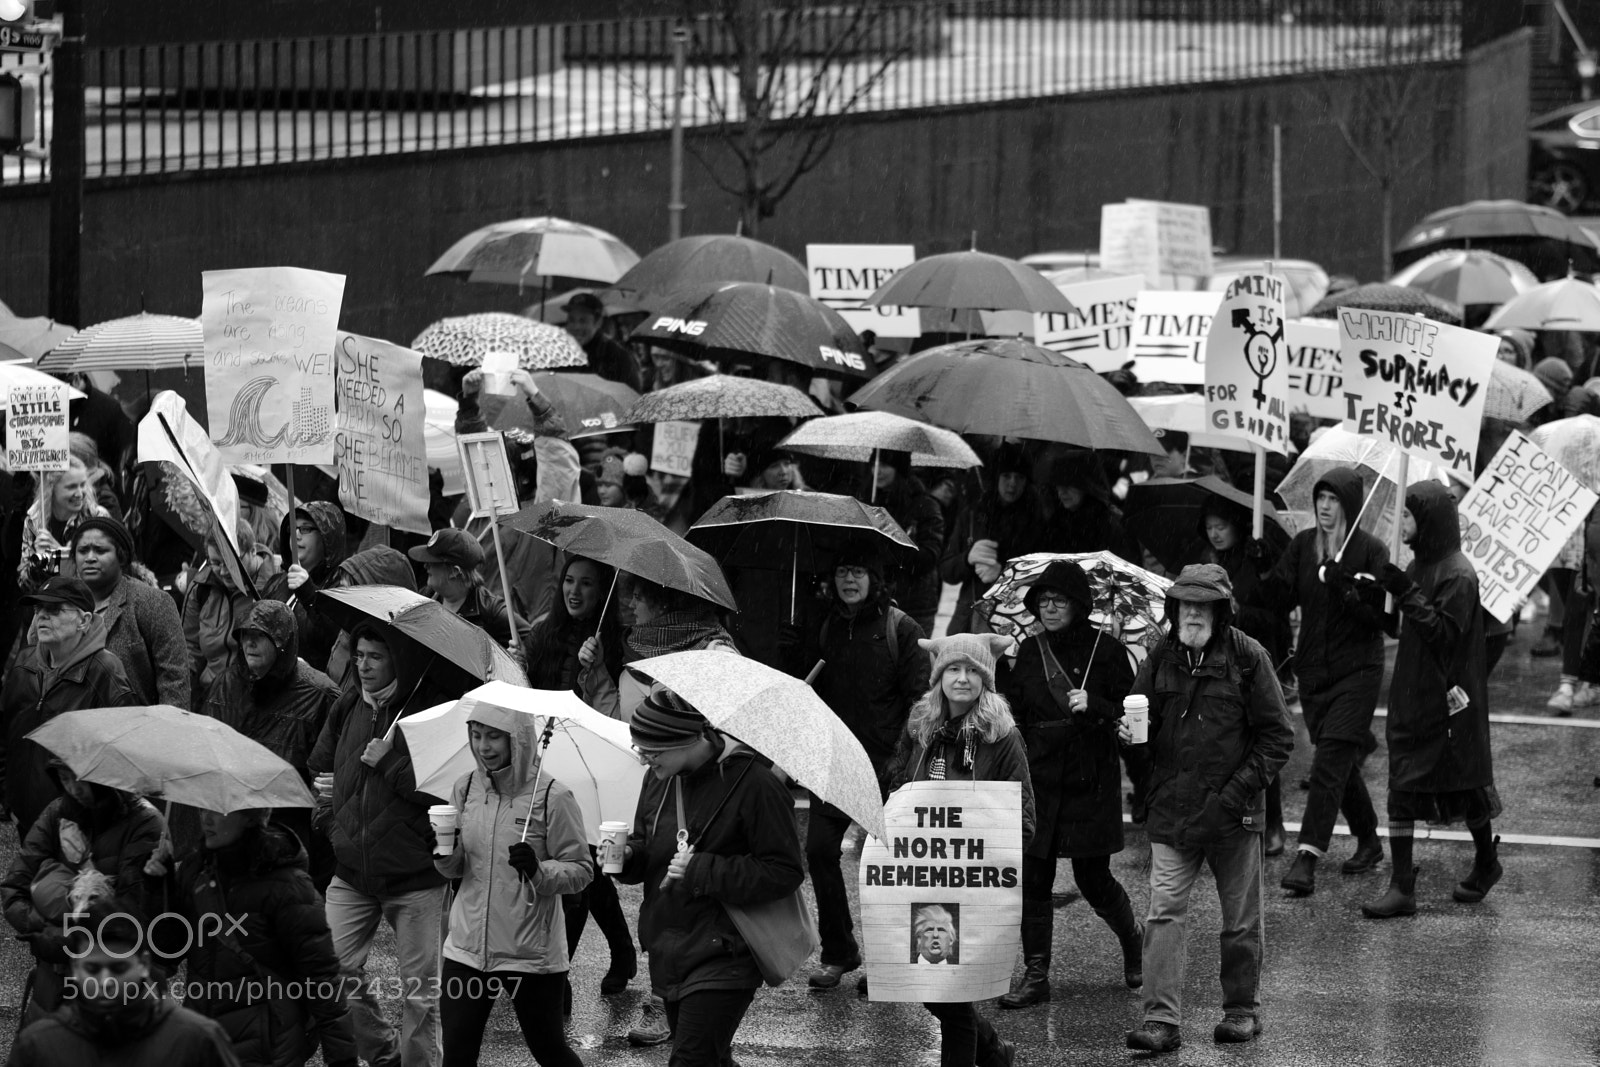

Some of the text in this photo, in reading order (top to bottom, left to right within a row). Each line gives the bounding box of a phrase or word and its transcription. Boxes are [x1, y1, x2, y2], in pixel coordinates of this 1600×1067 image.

[0, 26, 20, 47] gs
[815, 268, 902, 290] TIME'
[1226, 275, 1282, 303] EMINI
[221, 289, 254, 315] The
[1258, 305, 1274, 325] IS
[223, 325, 250, 341] are
[652, 317, 708, 336] PING
[1140, 315, 1213, 337] TIME
[1341, 312, 1439, 357] WHITE
[213, 345, 241, 367] and
[294, 352, 332, 376] WE!
[342, 335, 380, 383] SHE
[819, 345, 866, 371] PING
[1193, 341, 1206, 364] U
[1286, 344, 1343, 373] ME'S
[1305, 373, 1343, 398] UP
[1359, 349, 1479, 407] SUPREMACY
[11, 400, 61, 416] LITTLE
[338, 377, 405, 416] NEEDED A
[1207, 384, 1286, 422] FOR ALL
[1393, 391, 1417, 417] IS
[38, 427, 46, 436] A
[382, 414, 402, 443] SO
[664, 424, 697, 442] BELIEV
[1343, 392, 1473, 472] TERRORISM
[21, 438, 45, 450] BIG
[1508, 436, 1529, 457] I
[336, 432, 422, 484] SHE BECAME
[340, 463, 368, 500] ONE
[1496, 454, 1577, 527] BELIEVE
[1481, 474, 1550, 541] I STILL
[1468, 493, 1540, 555] HAVE TO
[914, 806, 963, 829] THE
[893, 837, 985, 860] NORTH
[866, 864, 1018, 888] REMEMBERS
